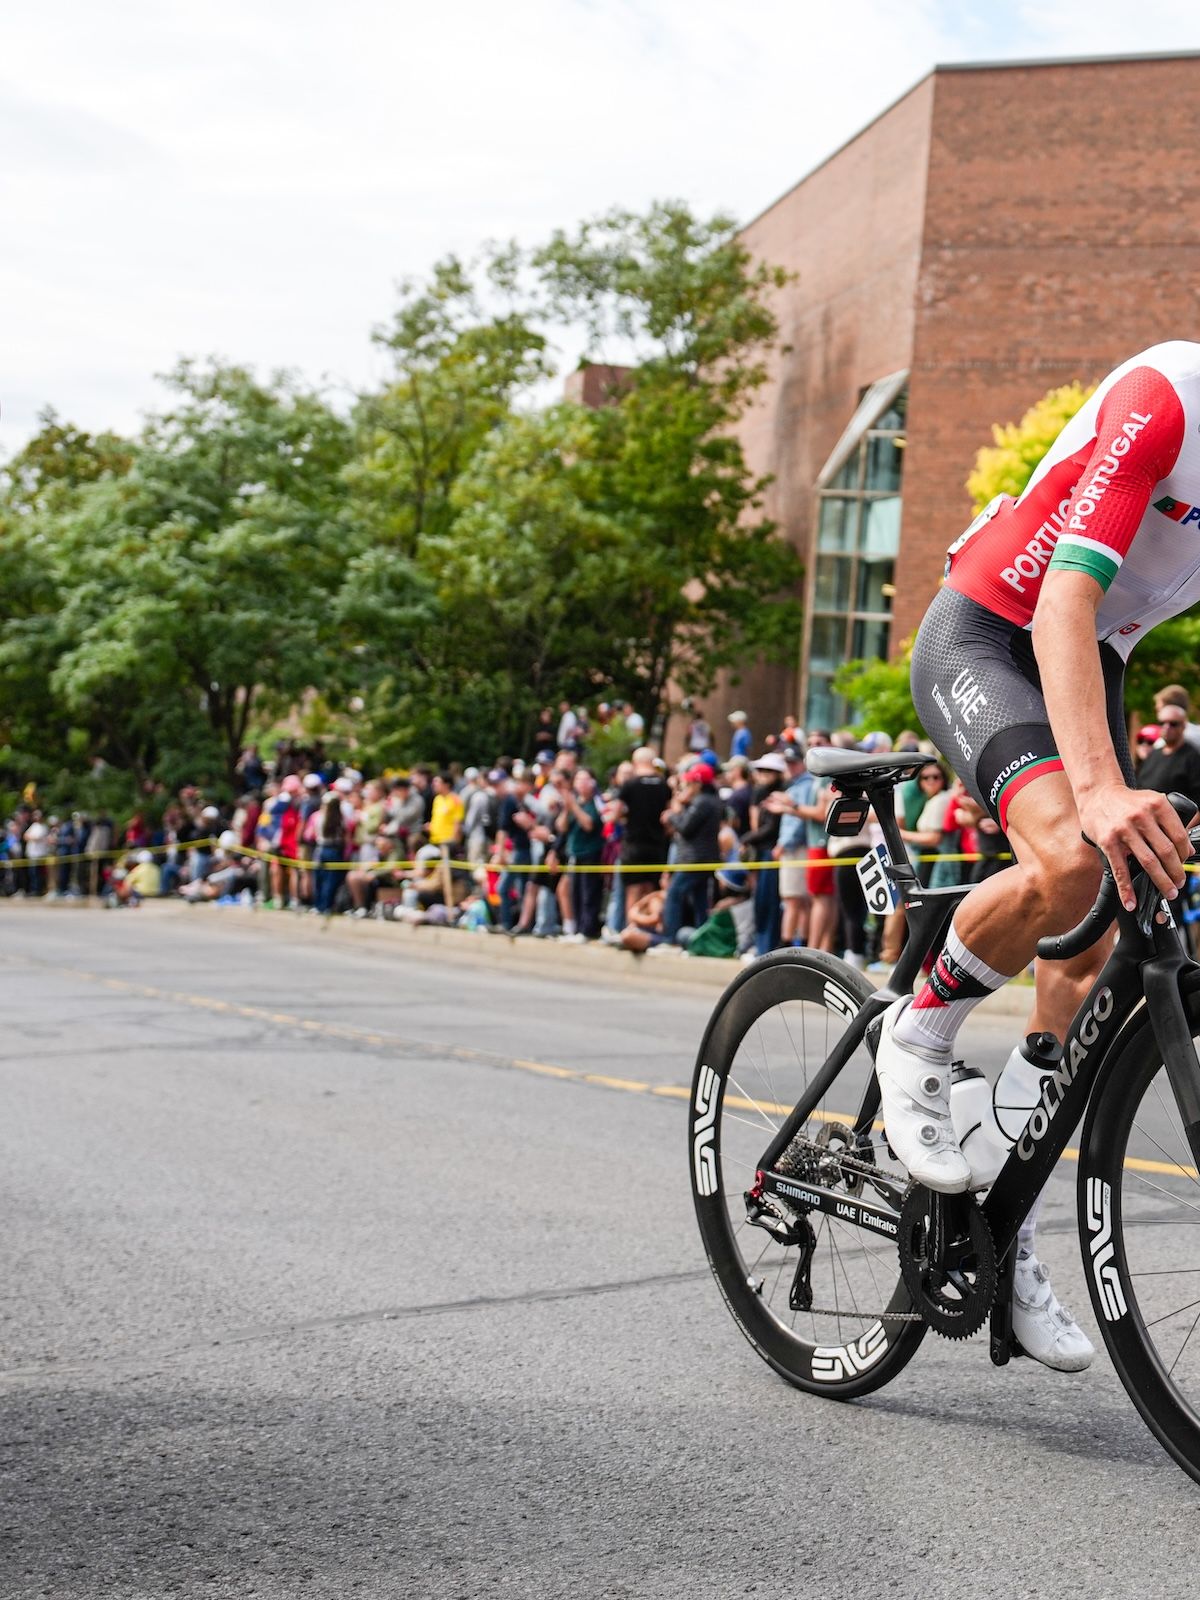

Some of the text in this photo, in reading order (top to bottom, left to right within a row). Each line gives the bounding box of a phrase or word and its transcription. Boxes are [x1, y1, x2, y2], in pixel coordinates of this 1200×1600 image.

[1069, 411, 1153, 531] PORTUGAL
[931, 683, 973, 761] Emirates XRG
[951, 668, 987, 725] UAE
[989, 751, 1038, 805] PORTUGAL
[859, 853, 888, 912] 119
[1016, 985, 1114, 1161] COLNAGO
[776, 1182, 821, 1206] SHIMANO
[836, 1203, 898, 1235] UAE Emirates
